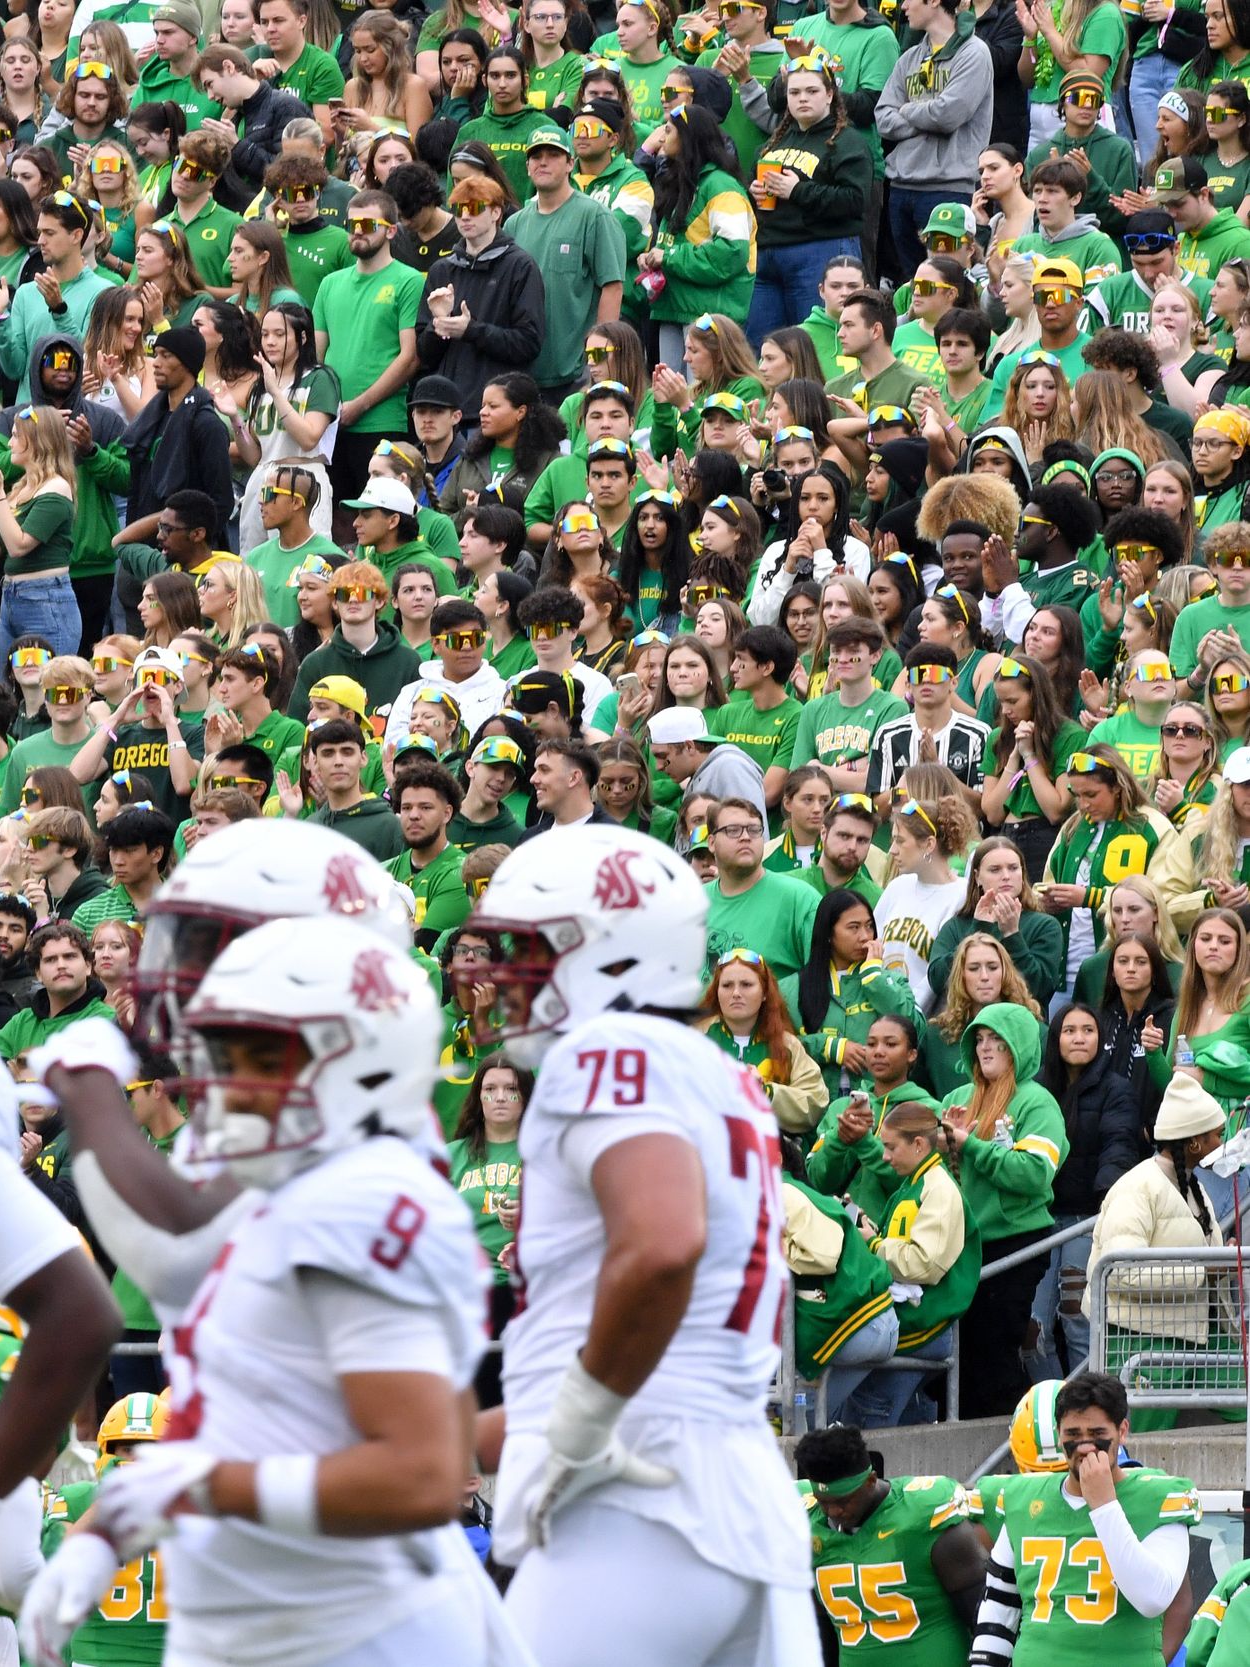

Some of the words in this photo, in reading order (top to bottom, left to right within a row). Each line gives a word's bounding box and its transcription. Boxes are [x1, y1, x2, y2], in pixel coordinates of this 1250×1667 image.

[201, 228, 218, 241] O
[726, 733, 781, 745] OREGON
[112, 743, 170, 771] OREGO
[459, 1162, 523, 1192] OREGO
[1021, 1536, 1119, 1626] 73
[816, 1562, 920, 1646] 55
